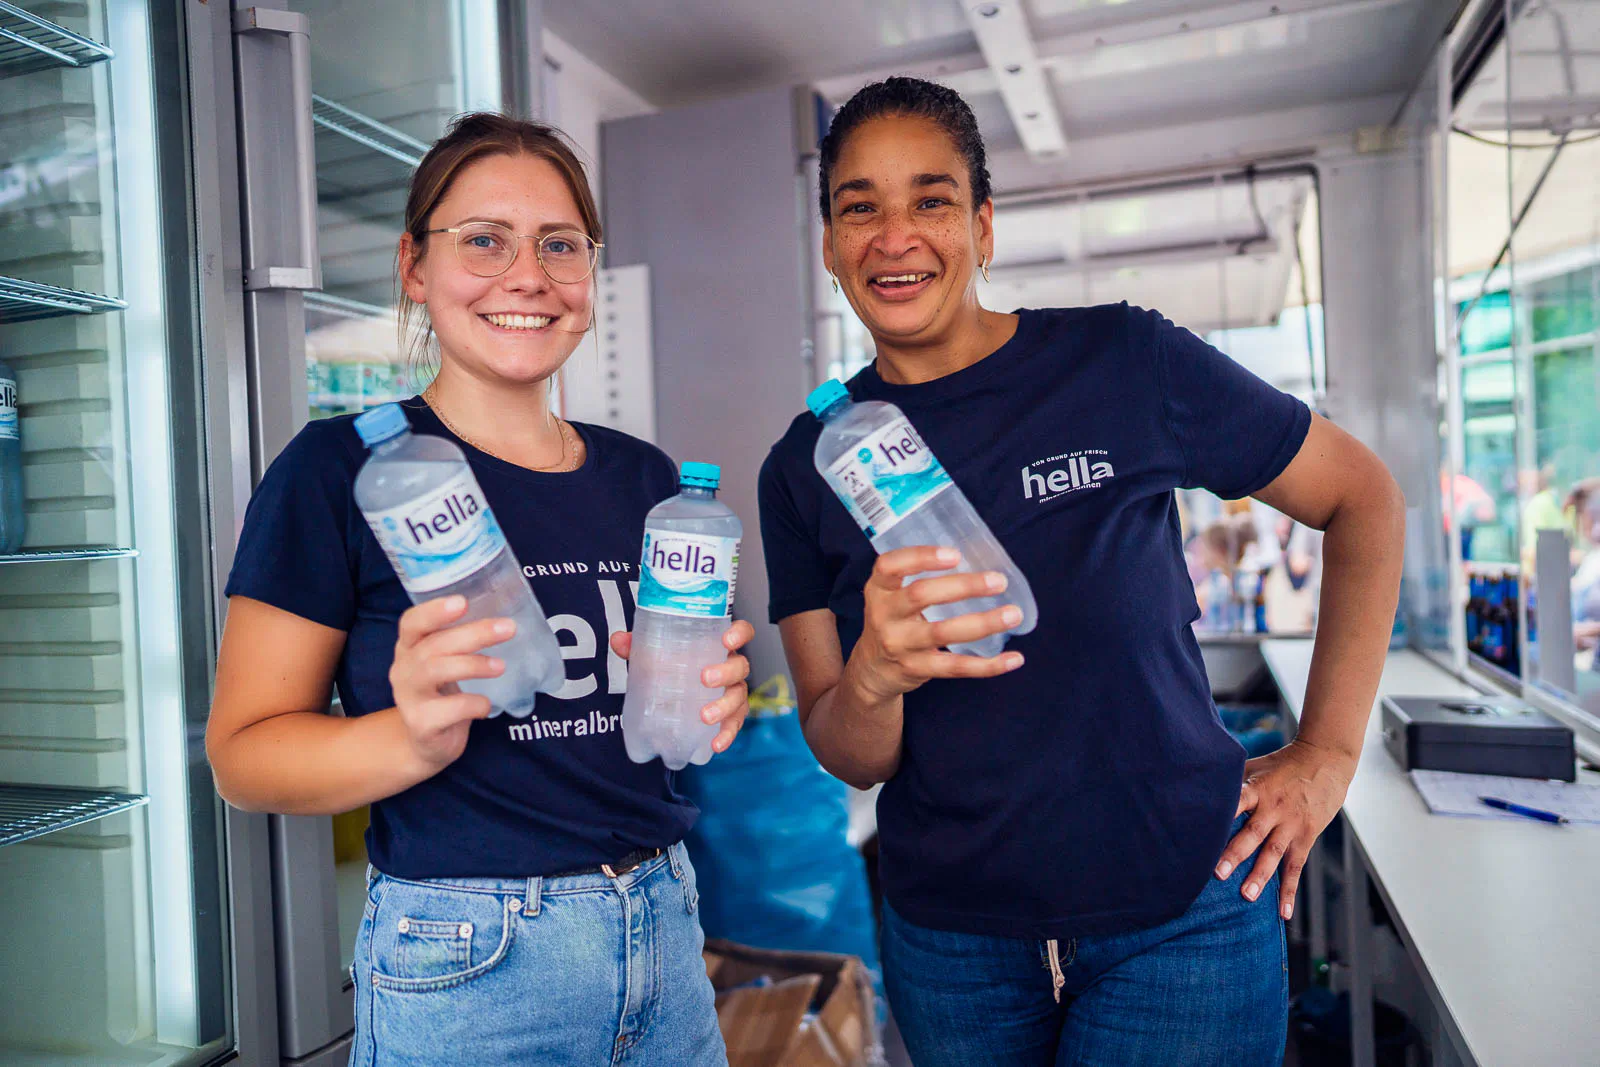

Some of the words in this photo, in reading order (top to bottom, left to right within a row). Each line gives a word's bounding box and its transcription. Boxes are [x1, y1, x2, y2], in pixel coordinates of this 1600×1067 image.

[1031, 459, 1045, 468] VON
[1046, 453, 1068, 463] GRUND
[1070, 450, 1083, 458] AUF
[1021, 456, 1115, 499] hella
[404, 493, 479, 545] hella
[522, 562, 589, 578] GRUND
[598, 560, 631, 573] AUF
[652, 540, 716, 575] hella
[508, 710, 625, 741] mineralbr
